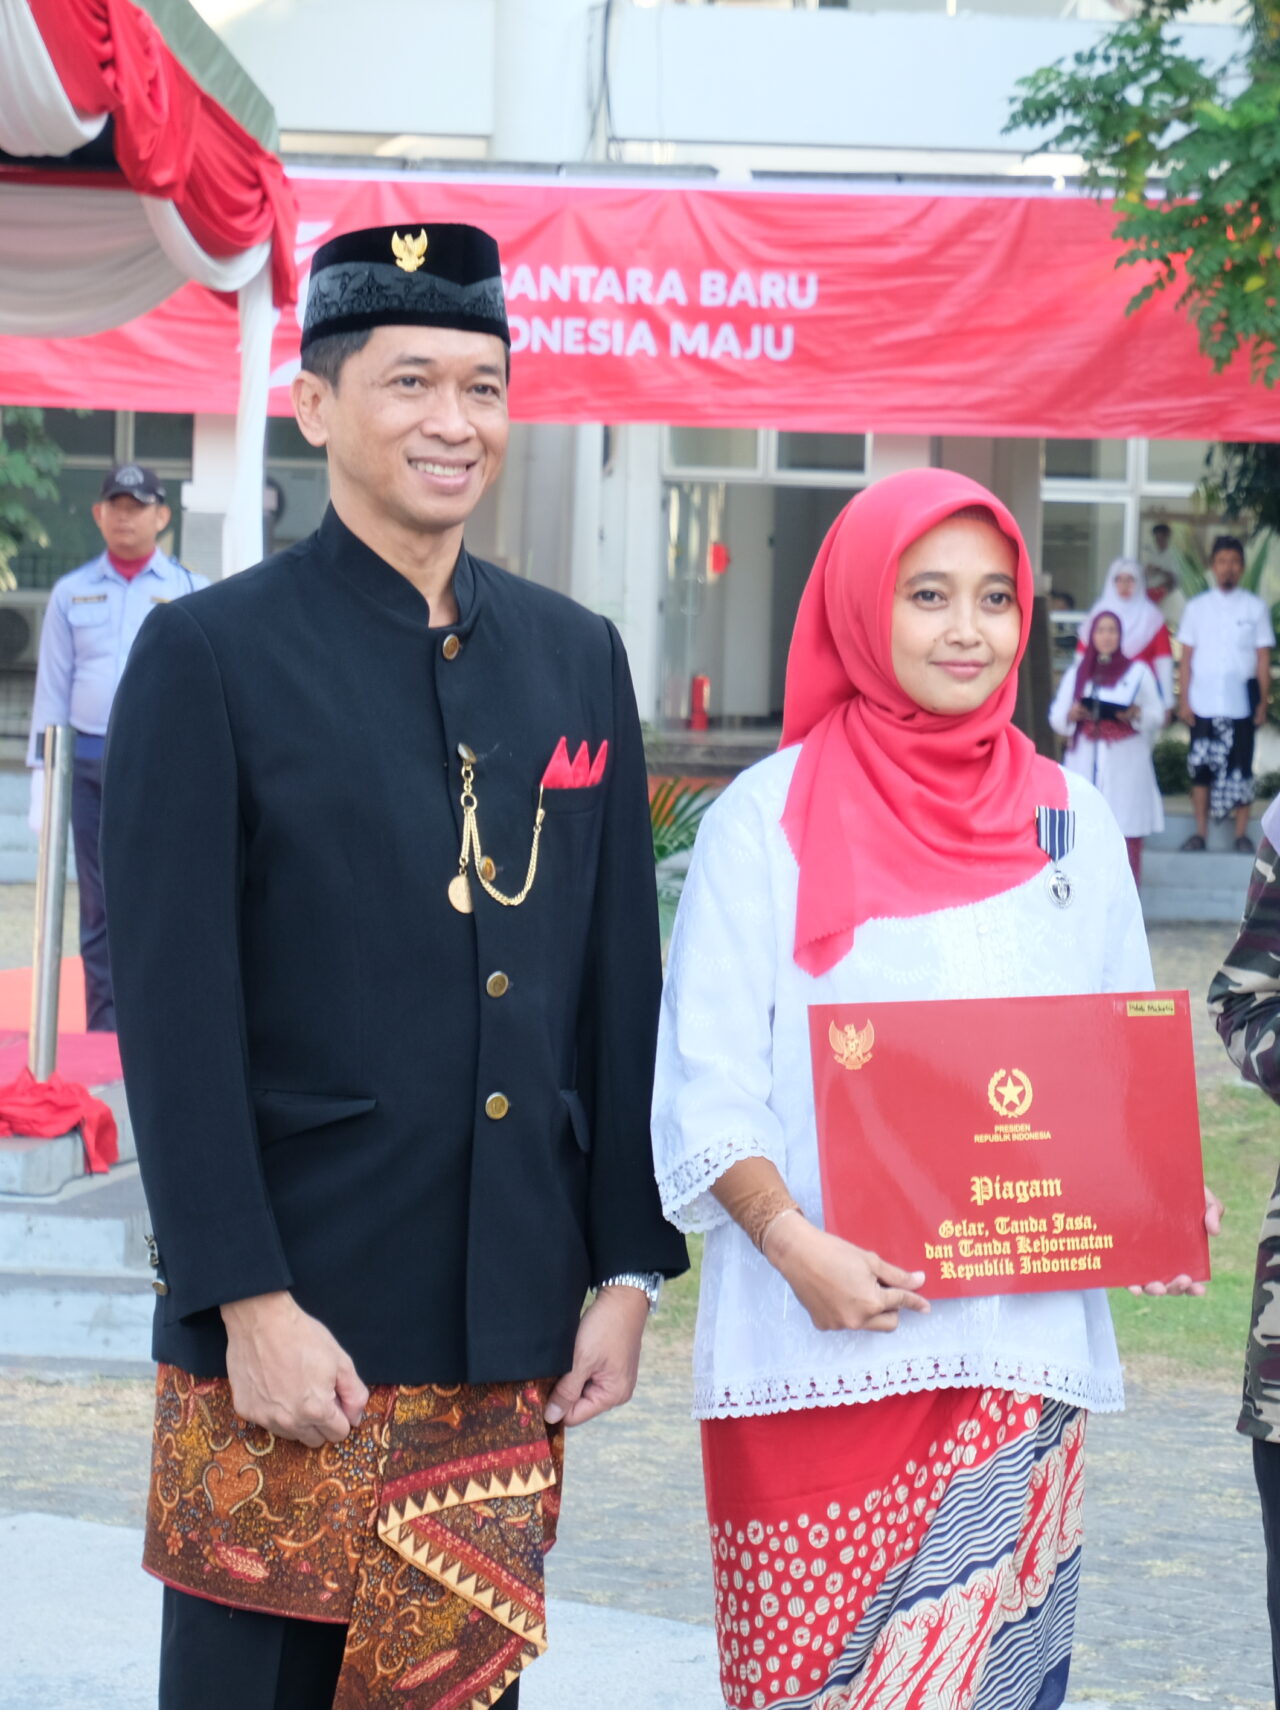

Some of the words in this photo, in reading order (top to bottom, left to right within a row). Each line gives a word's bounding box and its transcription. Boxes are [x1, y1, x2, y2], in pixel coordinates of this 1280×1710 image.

[700, 269, 819, 309] BARU
[670, 321, 795, 361] MAJU
[974, 1133, 1011, 1143] REPUBLIK
[1012, 1131, 1052, 1141] INDONESIA
[994, 1124, 1031, 1133] PRESIDEN
[970, 1175, 1062, 1206] Piagam
[938, 1219, 989, 1239] Gelar,
[994, 1216, 1047, 1235] Tanda
[1051, 1212, 1097, 1234] Jasa,
[924, 1242, 953, 1259] dan
[958, 1238, 1011, 1258] Tanda
[1015, 1234, 1114, 1256] Kehormatan
[940, 1258, 1015, 1280] Republik
[1020, 1253, 1101, 1275] Indonesia
